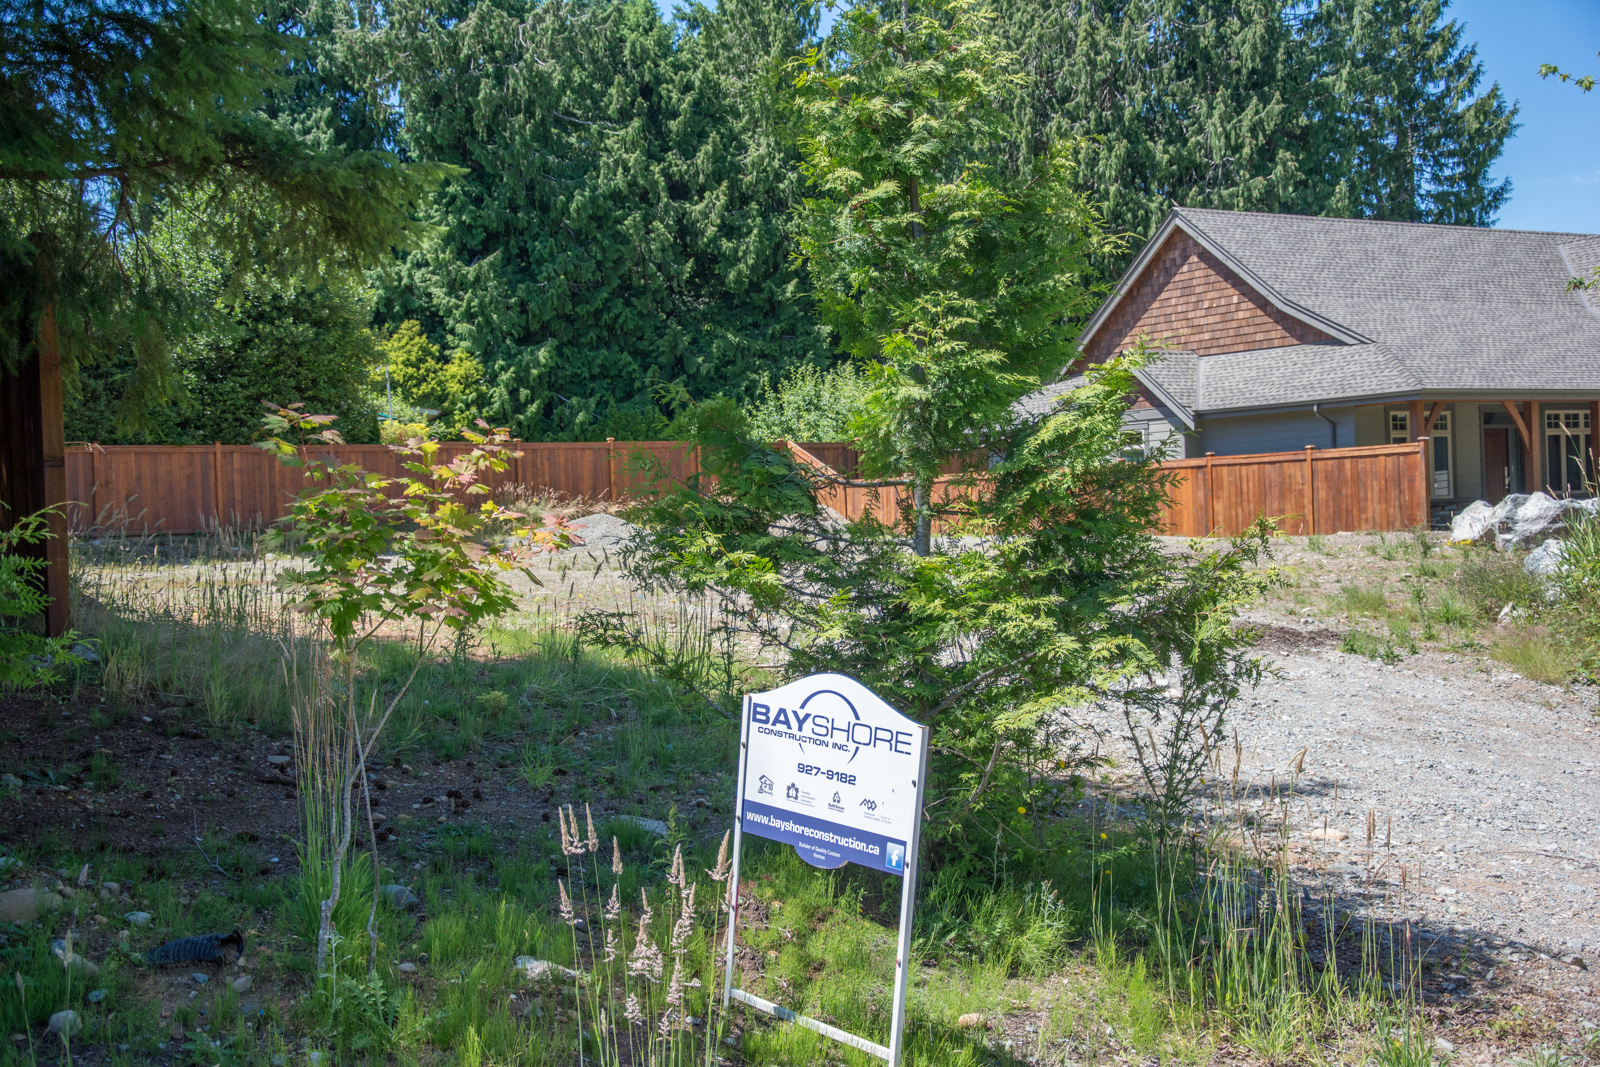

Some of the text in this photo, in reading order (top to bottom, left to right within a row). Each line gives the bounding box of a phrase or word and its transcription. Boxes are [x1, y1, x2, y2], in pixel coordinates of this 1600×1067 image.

[751, 702, 913, 756] BAYSHORE
[757, 726, 851, 753] CONSTRUCTION INC.
[797, 762, 857, 786] 927-9182
[746, 811, 880, 856] www.bayshoreconstruction.ca
[798, 841, 811, 850] Builder
[815, 846, 827, 855] Quality
[827, 849, 841, 858] Custom
